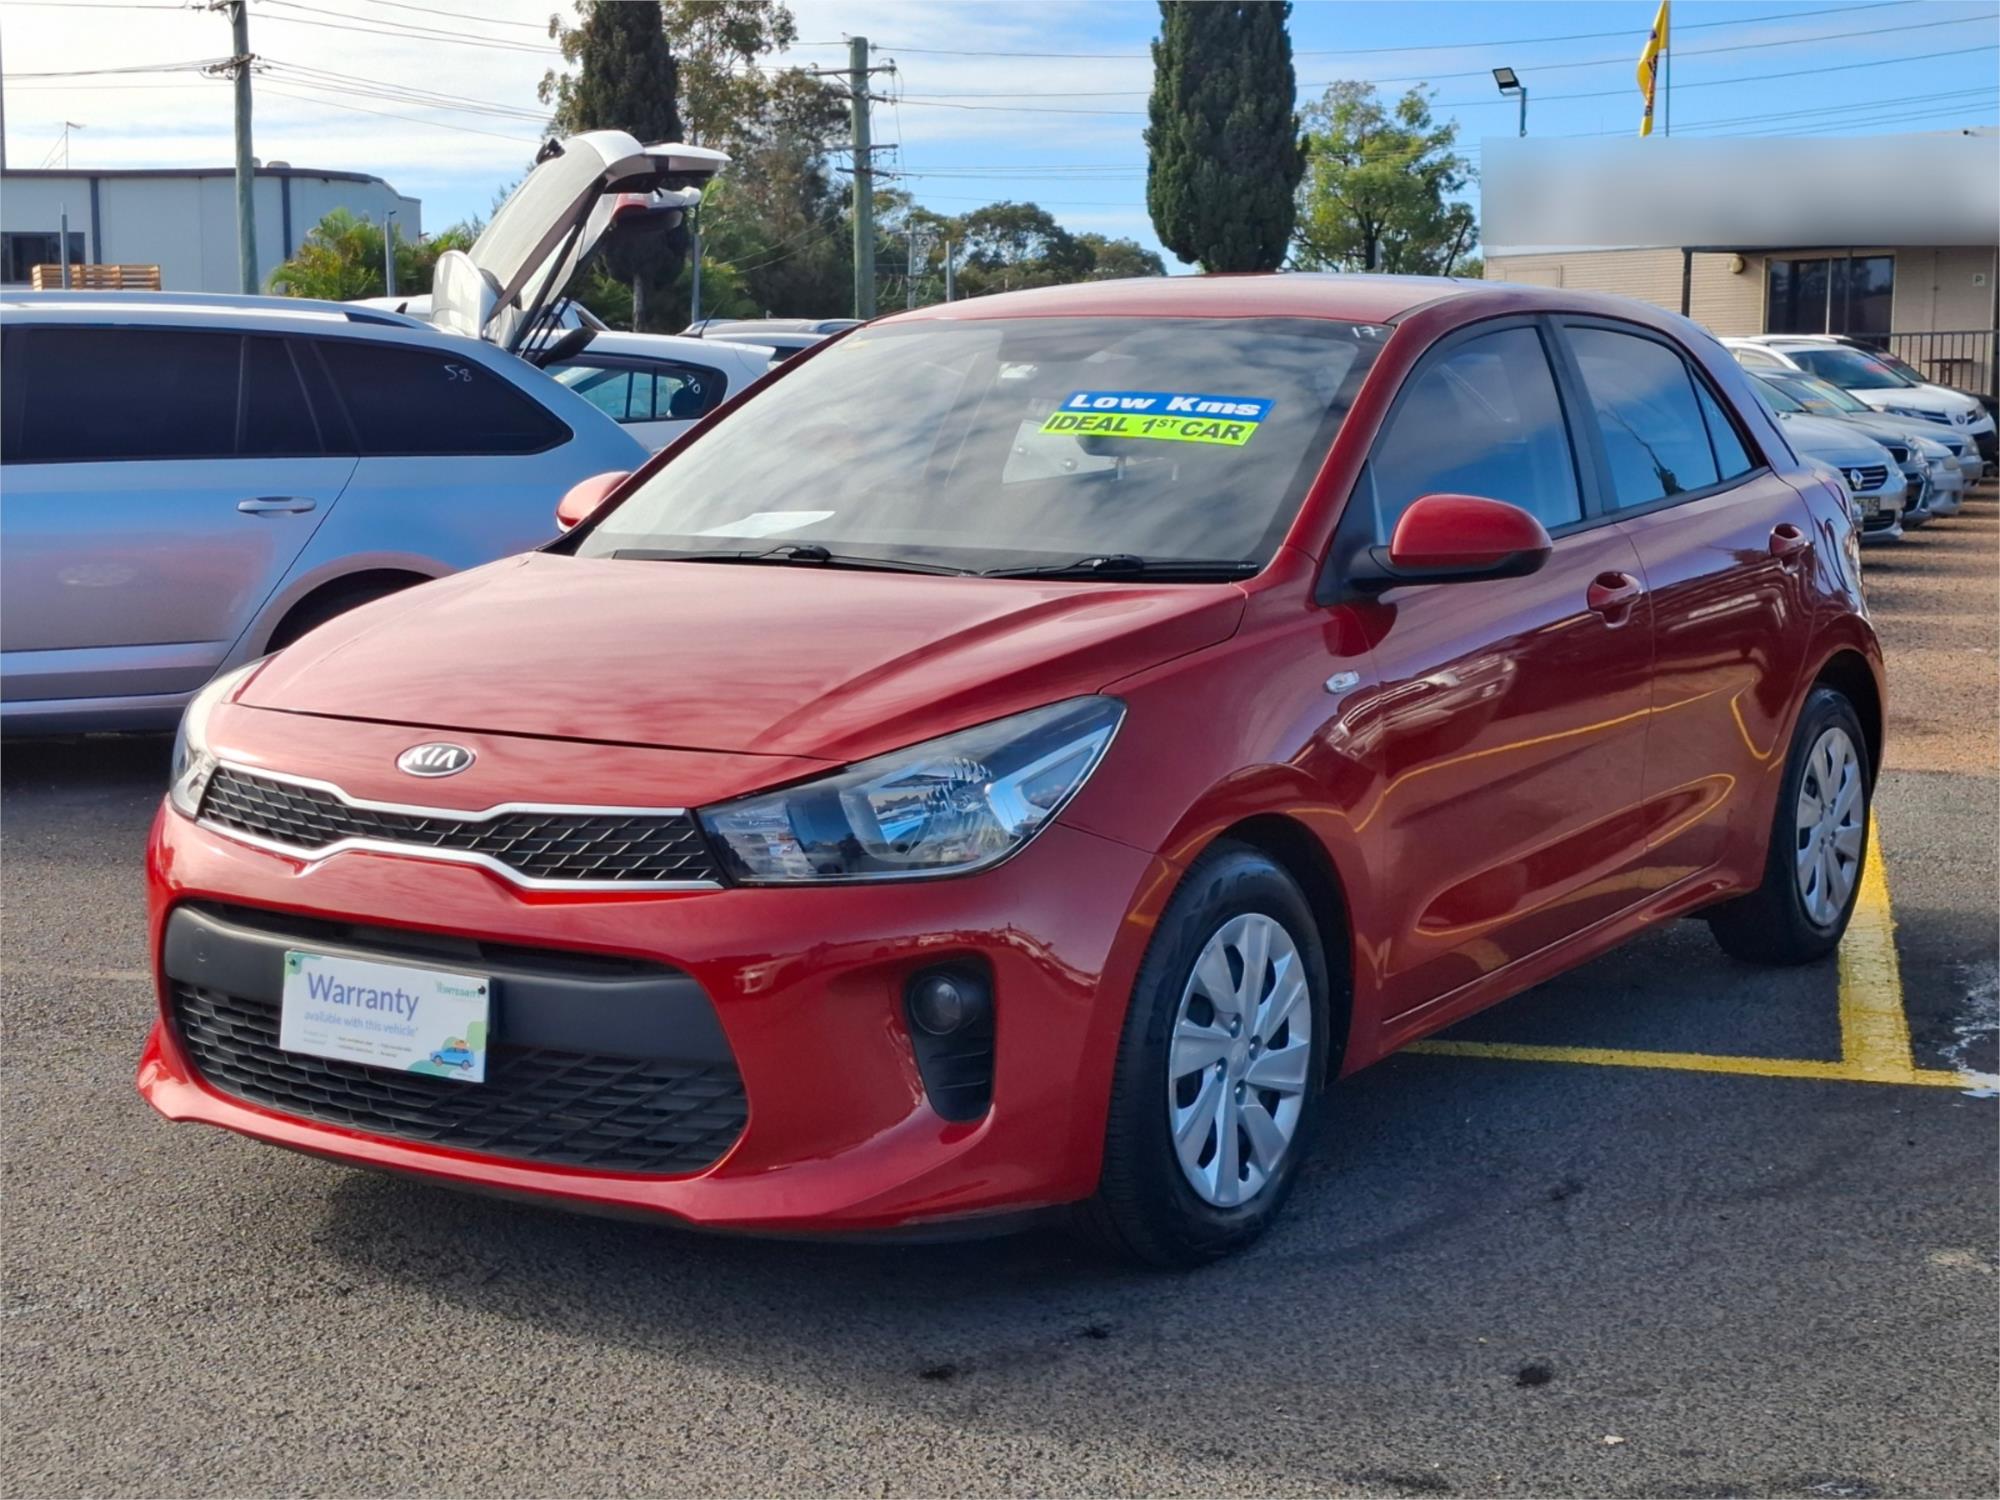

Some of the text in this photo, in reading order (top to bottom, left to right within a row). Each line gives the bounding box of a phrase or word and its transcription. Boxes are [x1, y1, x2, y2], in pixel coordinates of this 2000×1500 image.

[444, 364, 472, 382] 58
[686, 374, 701, 394] 70
[1069, 394, 1261, 416] Low Kms
[1045, 415, 1129, 432] IDEAL
[1180, 421, 1246, 441] CAR
[400, 746, 459, 769] KIA
[307, 972, 420, 1021] Warranty
[303, 1011, 342, 1025] available
[344, 1016, 363, 1028] with
[365, 1019, 382, 1031] this
